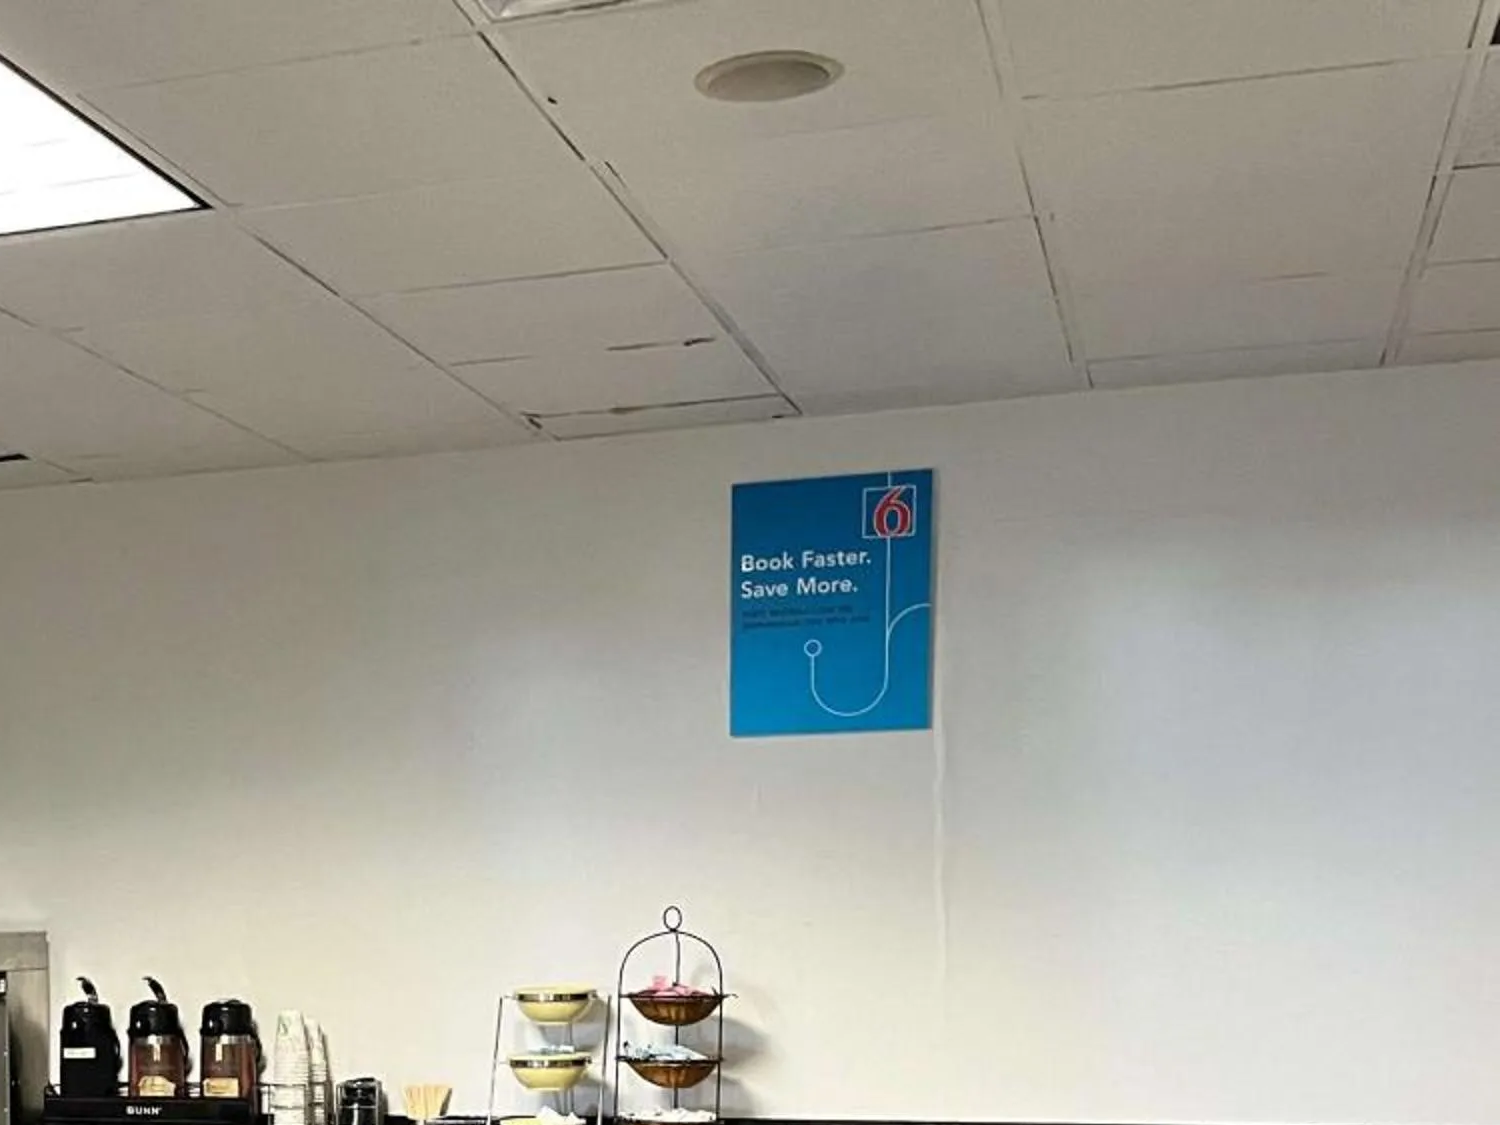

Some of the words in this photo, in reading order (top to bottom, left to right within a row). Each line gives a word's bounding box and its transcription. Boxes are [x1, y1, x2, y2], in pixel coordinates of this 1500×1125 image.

[873, 485, 911, 537] 6
[741, 552, 794, 572] Book
[802, 549, 871, 569] Faster.
[741, 581, 788, 598] Save
[797, 577, 858, 595] More.
